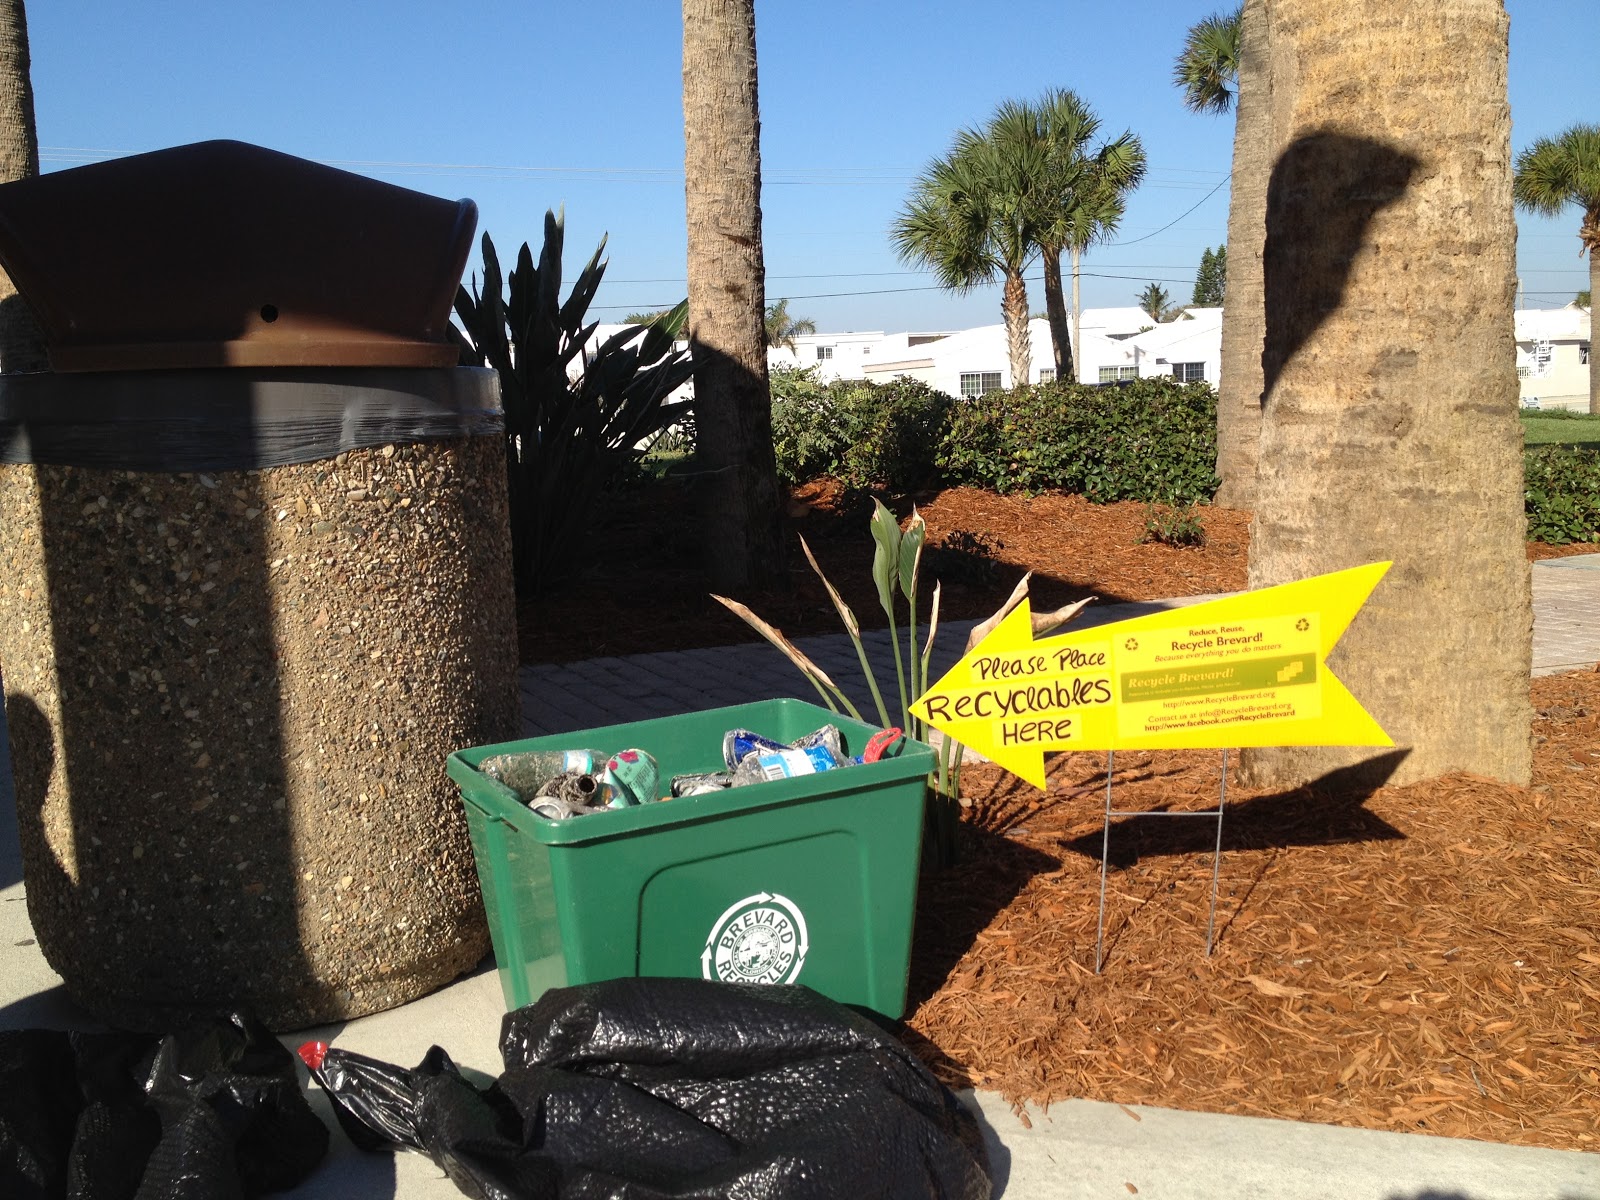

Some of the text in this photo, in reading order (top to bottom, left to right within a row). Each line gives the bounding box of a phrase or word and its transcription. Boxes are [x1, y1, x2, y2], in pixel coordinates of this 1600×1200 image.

[1171, 632, 1263, 651] Recycle Brevard!
[1189, 626, 1245, 637] Reduce, Reuse,
[1154, 653, 1184, 663] Because
[1185, 649, 1224, 661] everything
[1225, 648, 1239, 657] you
[1253, 643, 1282, 653] matters
[972, 648, 1106, 680] Please Place
[1128, 668, 1234, 688] Recycle Brevard!
[1148, 715, 1177, 723] Contact
[720, 910, 793, 949] BREVARD
